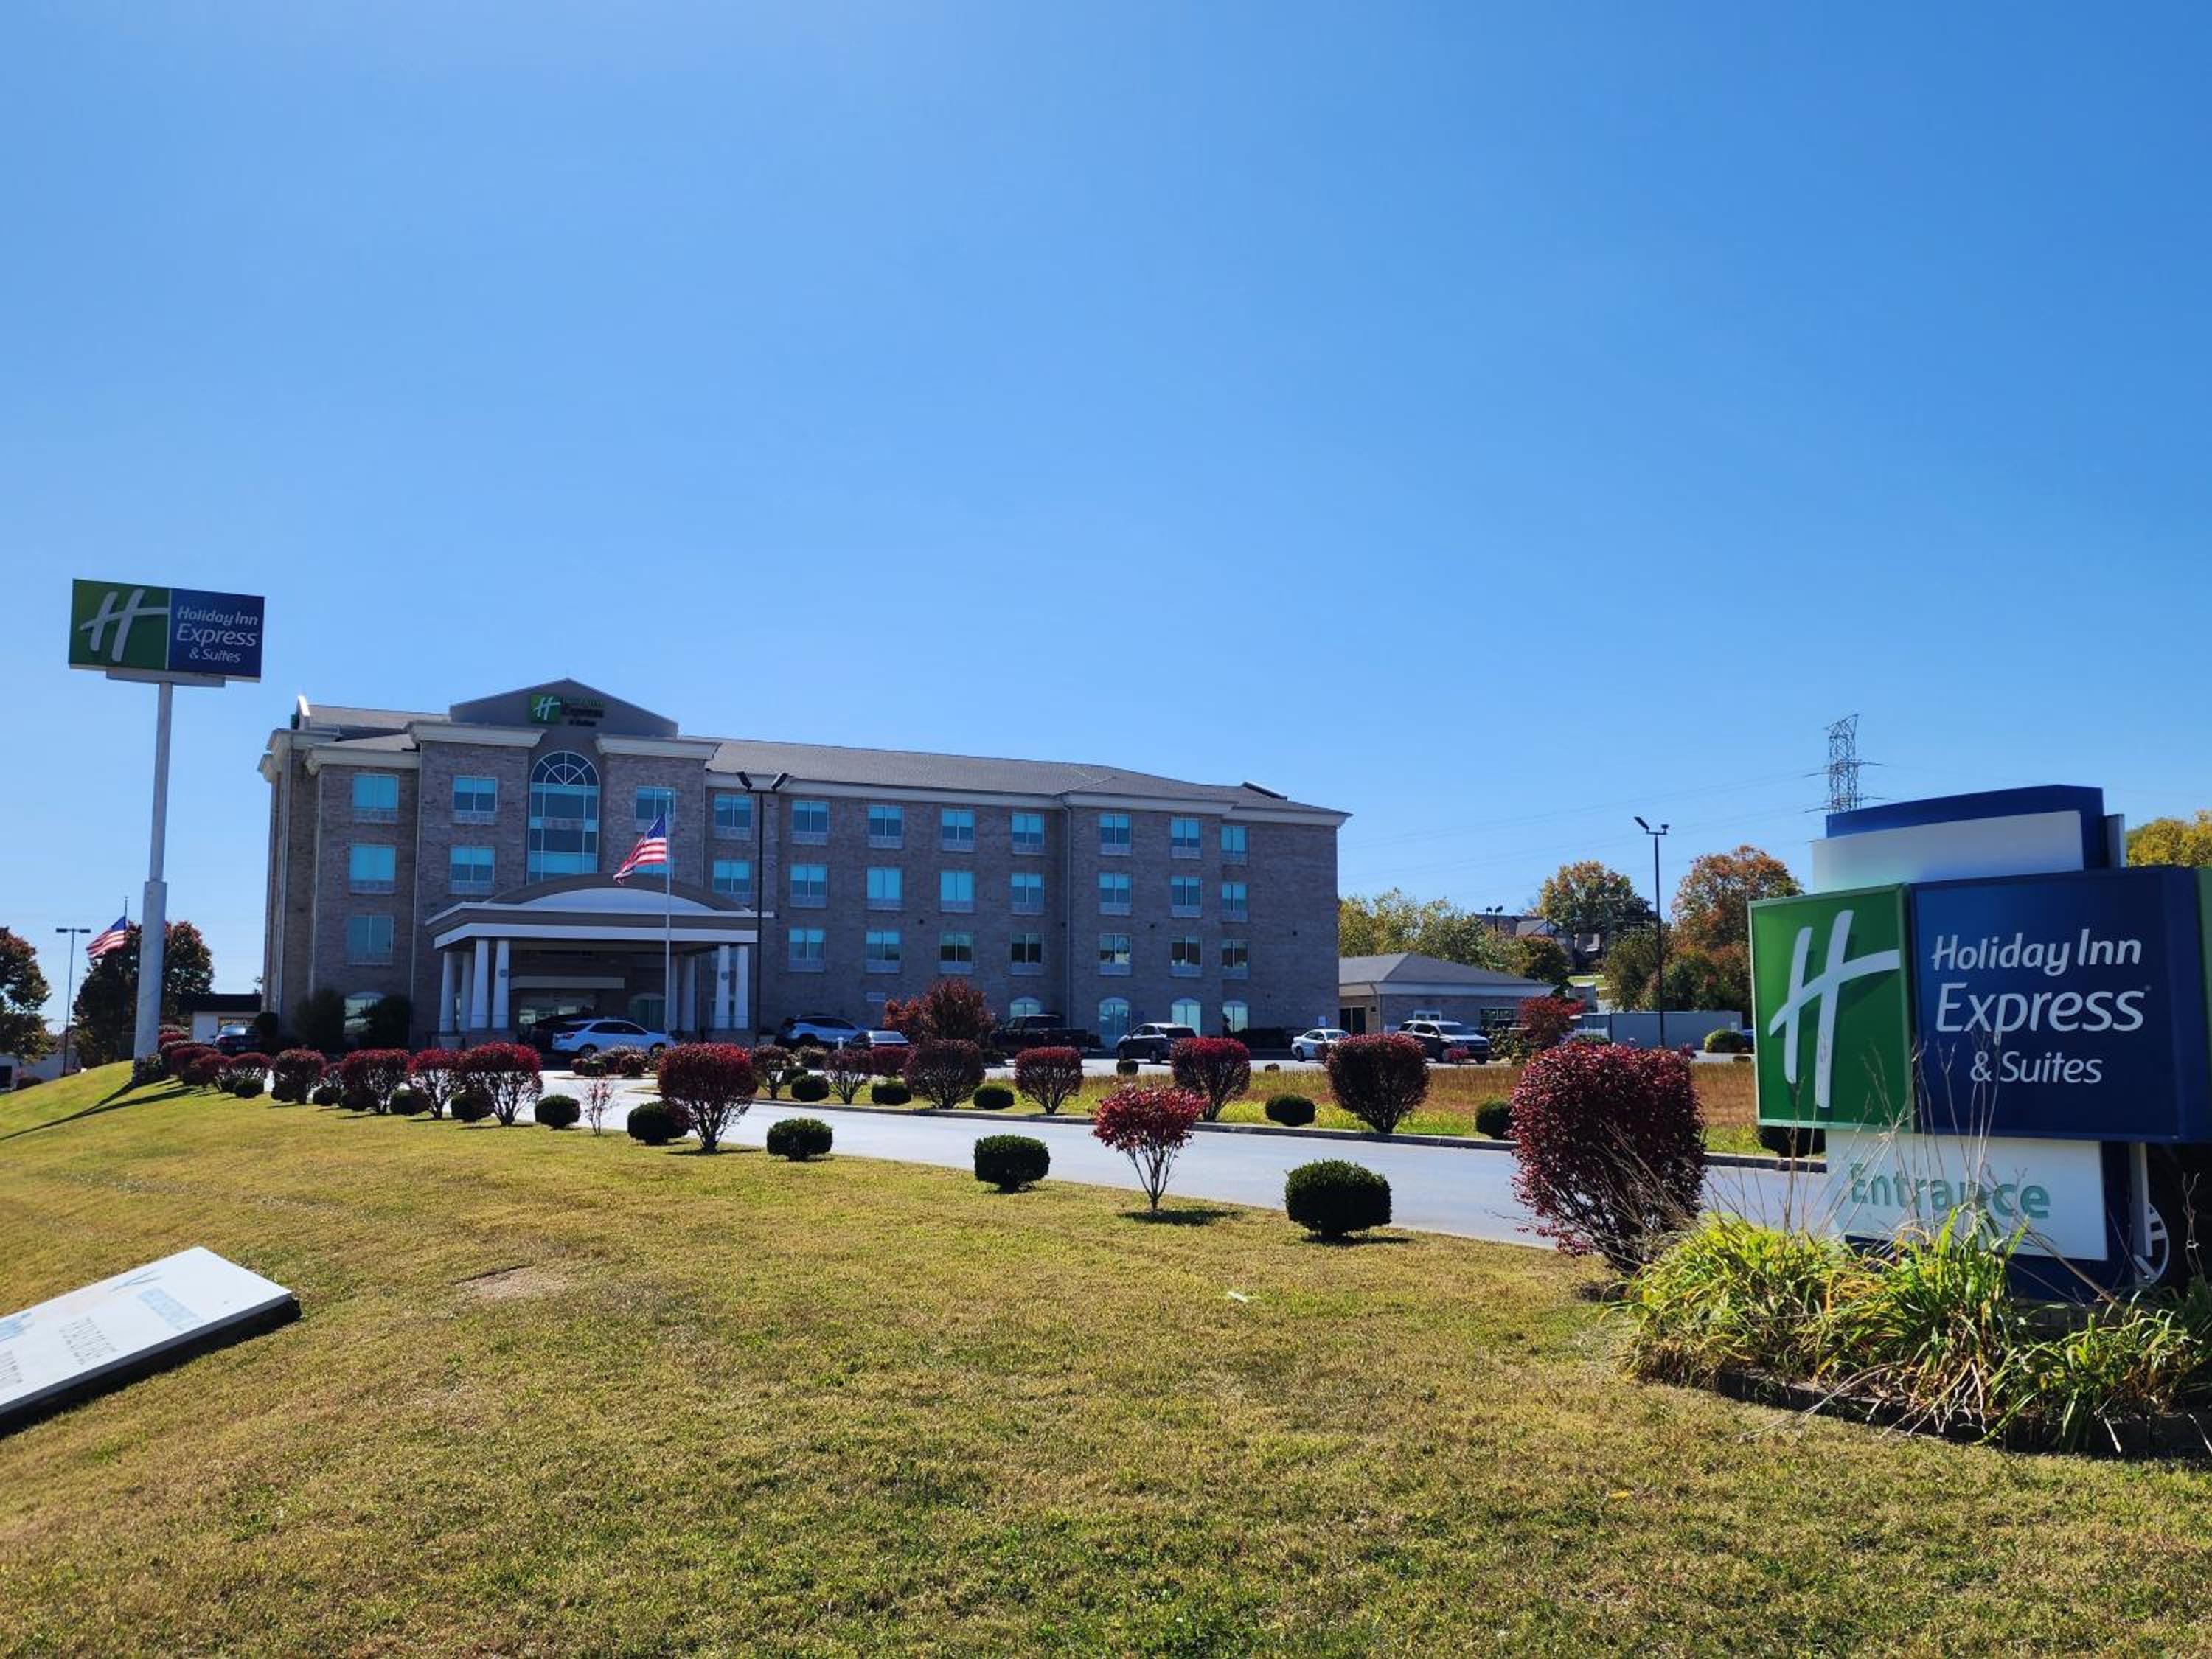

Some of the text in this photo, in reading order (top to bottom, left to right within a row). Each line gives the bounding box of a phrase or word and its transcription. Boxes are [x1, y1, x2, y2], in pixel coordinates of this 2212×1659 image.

[177, 605, 258, 626] Holiday Inn
[177, 623, 257, 647] Express
[189, 647, 241, 663] & Suites
[1931, 928, 2143, 977] Holiday Inn
[1935, 982, 2145, 1046] Express
[1970, 1051, 2103, 1083] & Suites
